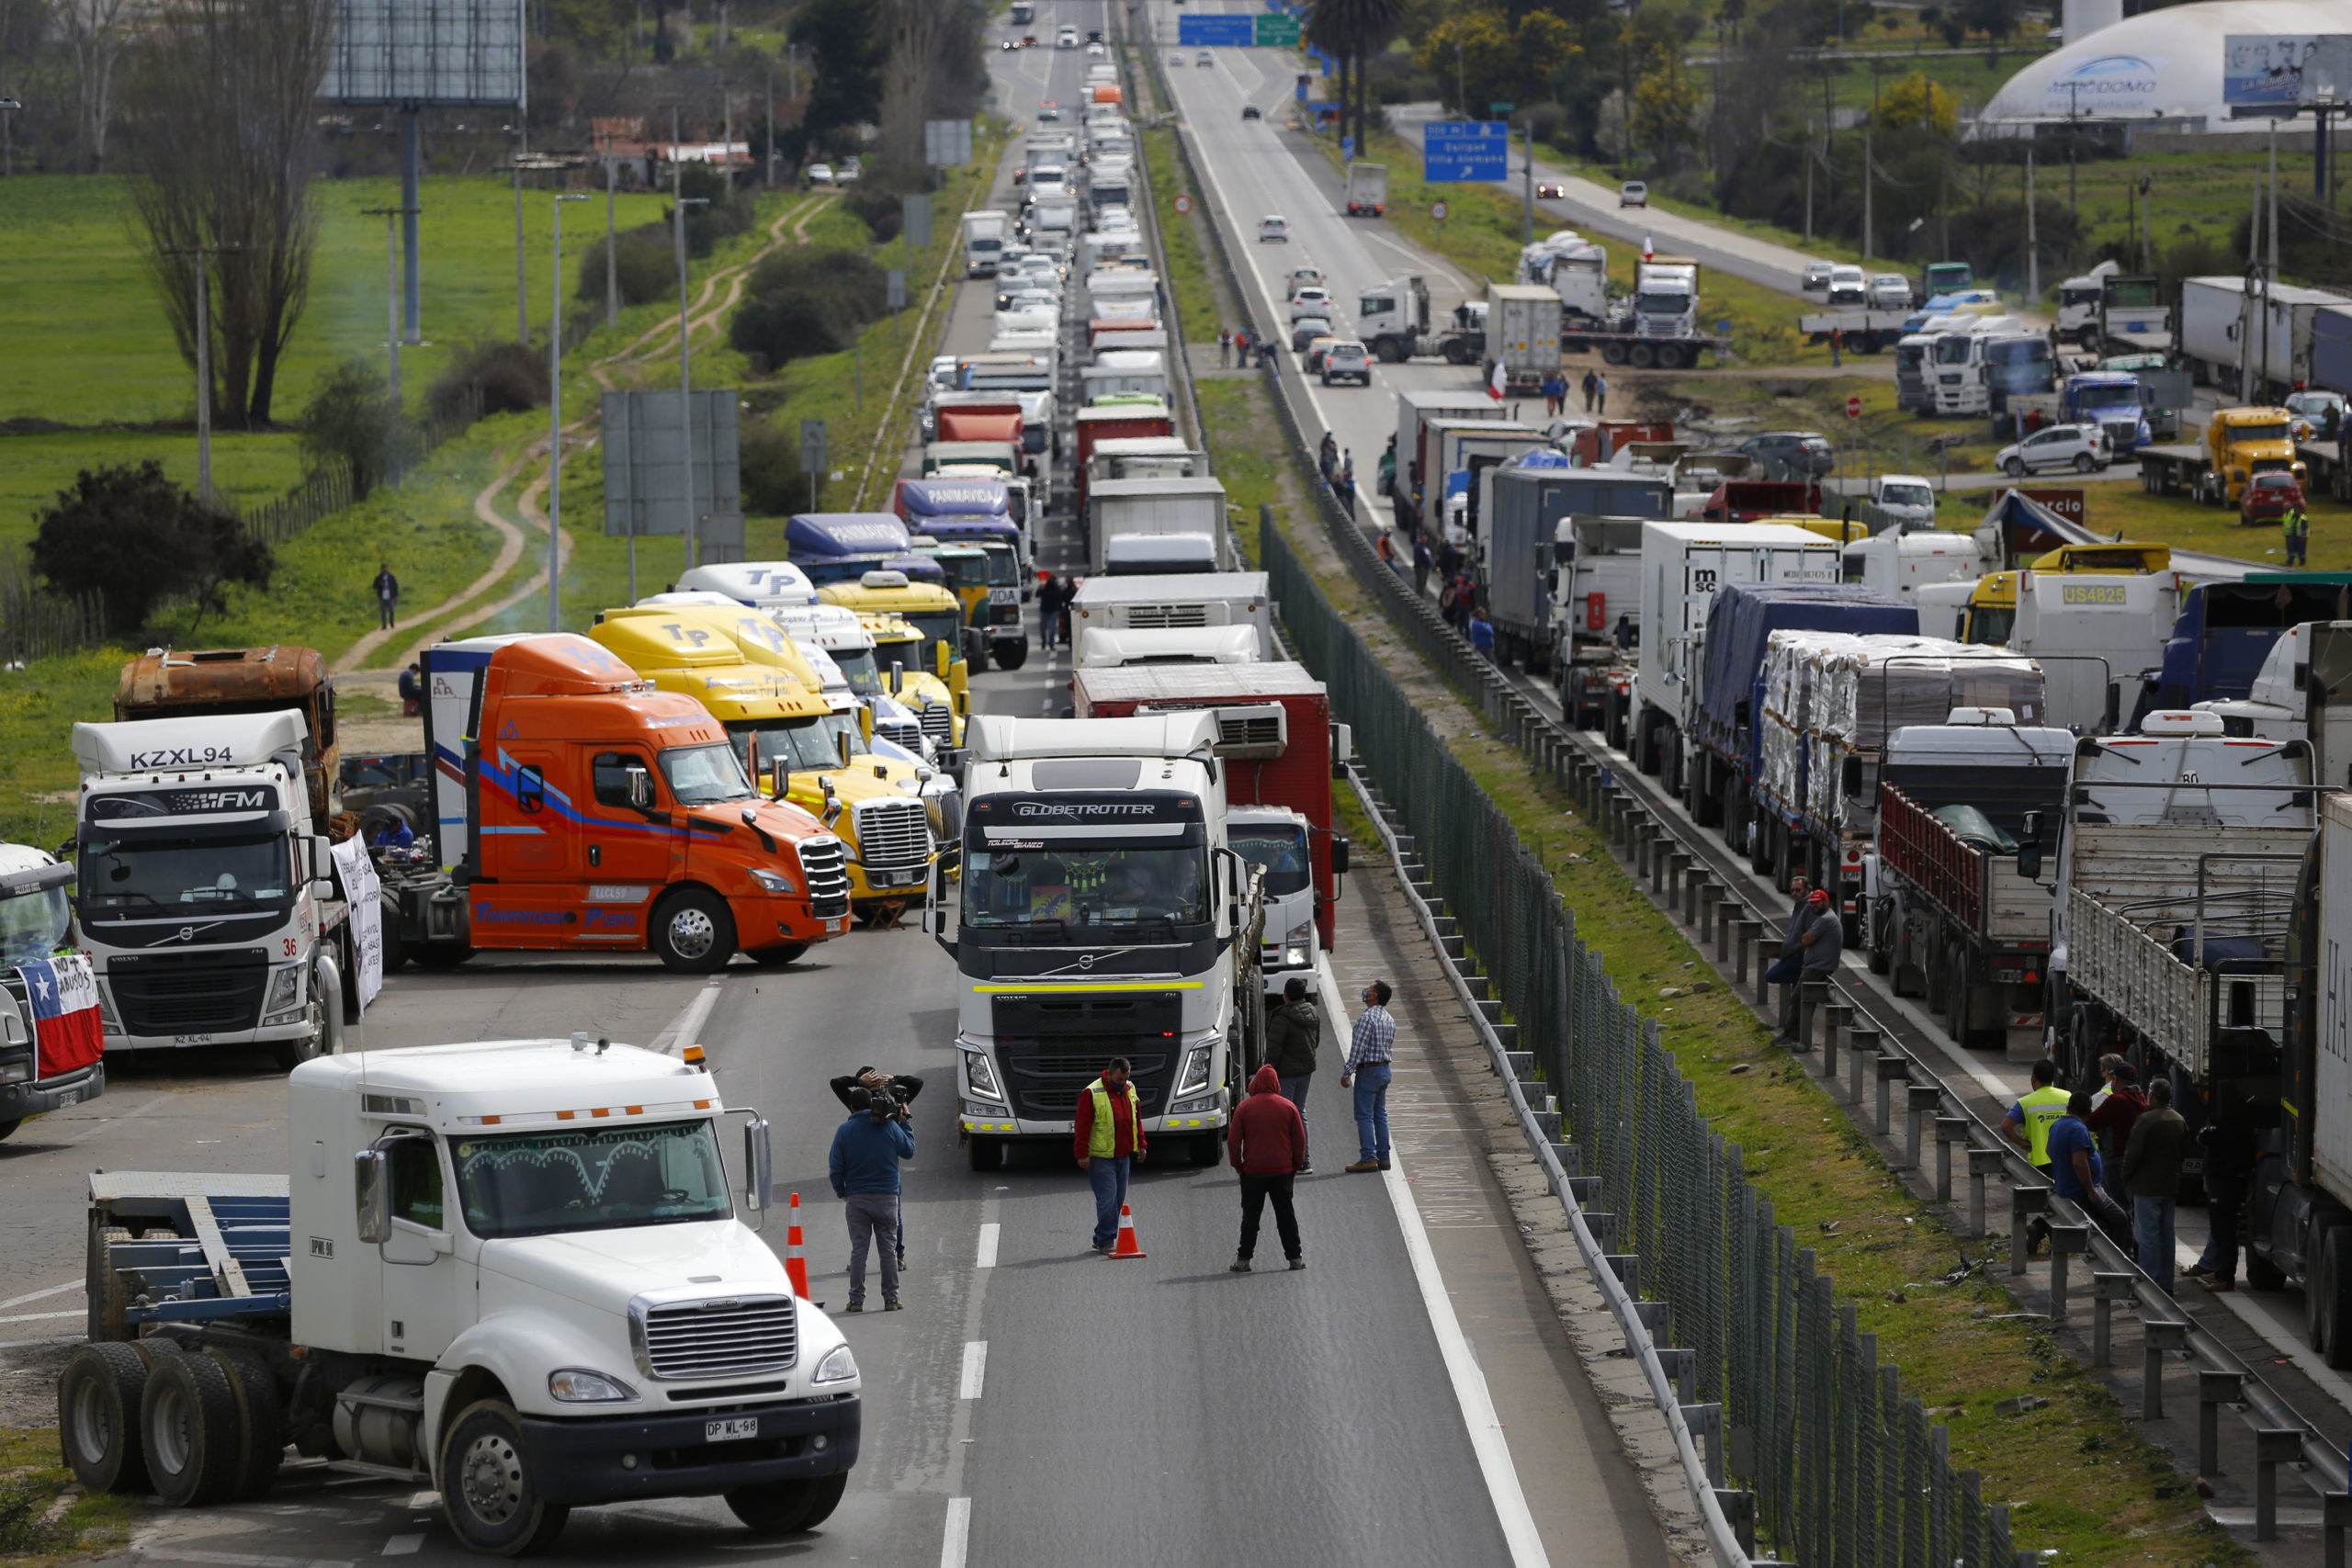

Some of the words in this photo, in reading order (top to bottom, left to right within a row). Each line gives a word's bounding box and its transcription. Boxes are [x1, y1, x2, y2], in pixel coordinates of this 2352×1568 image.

[928, 489, 995, 503] PANIMAVIDA
[2064, 587, 2125, 603] US4825
[130, 746, 232, 770] KZXL94
[217, 791, 265, 808] FM
[1019, 804, 1155, 817] GLOBETROTTER
[283, 938, 297, 956] 36
[53, 956, 69, 975] NO
[59, 972, 91, 995] ABUSOS
[707, 1423, 721, 1437] DP
